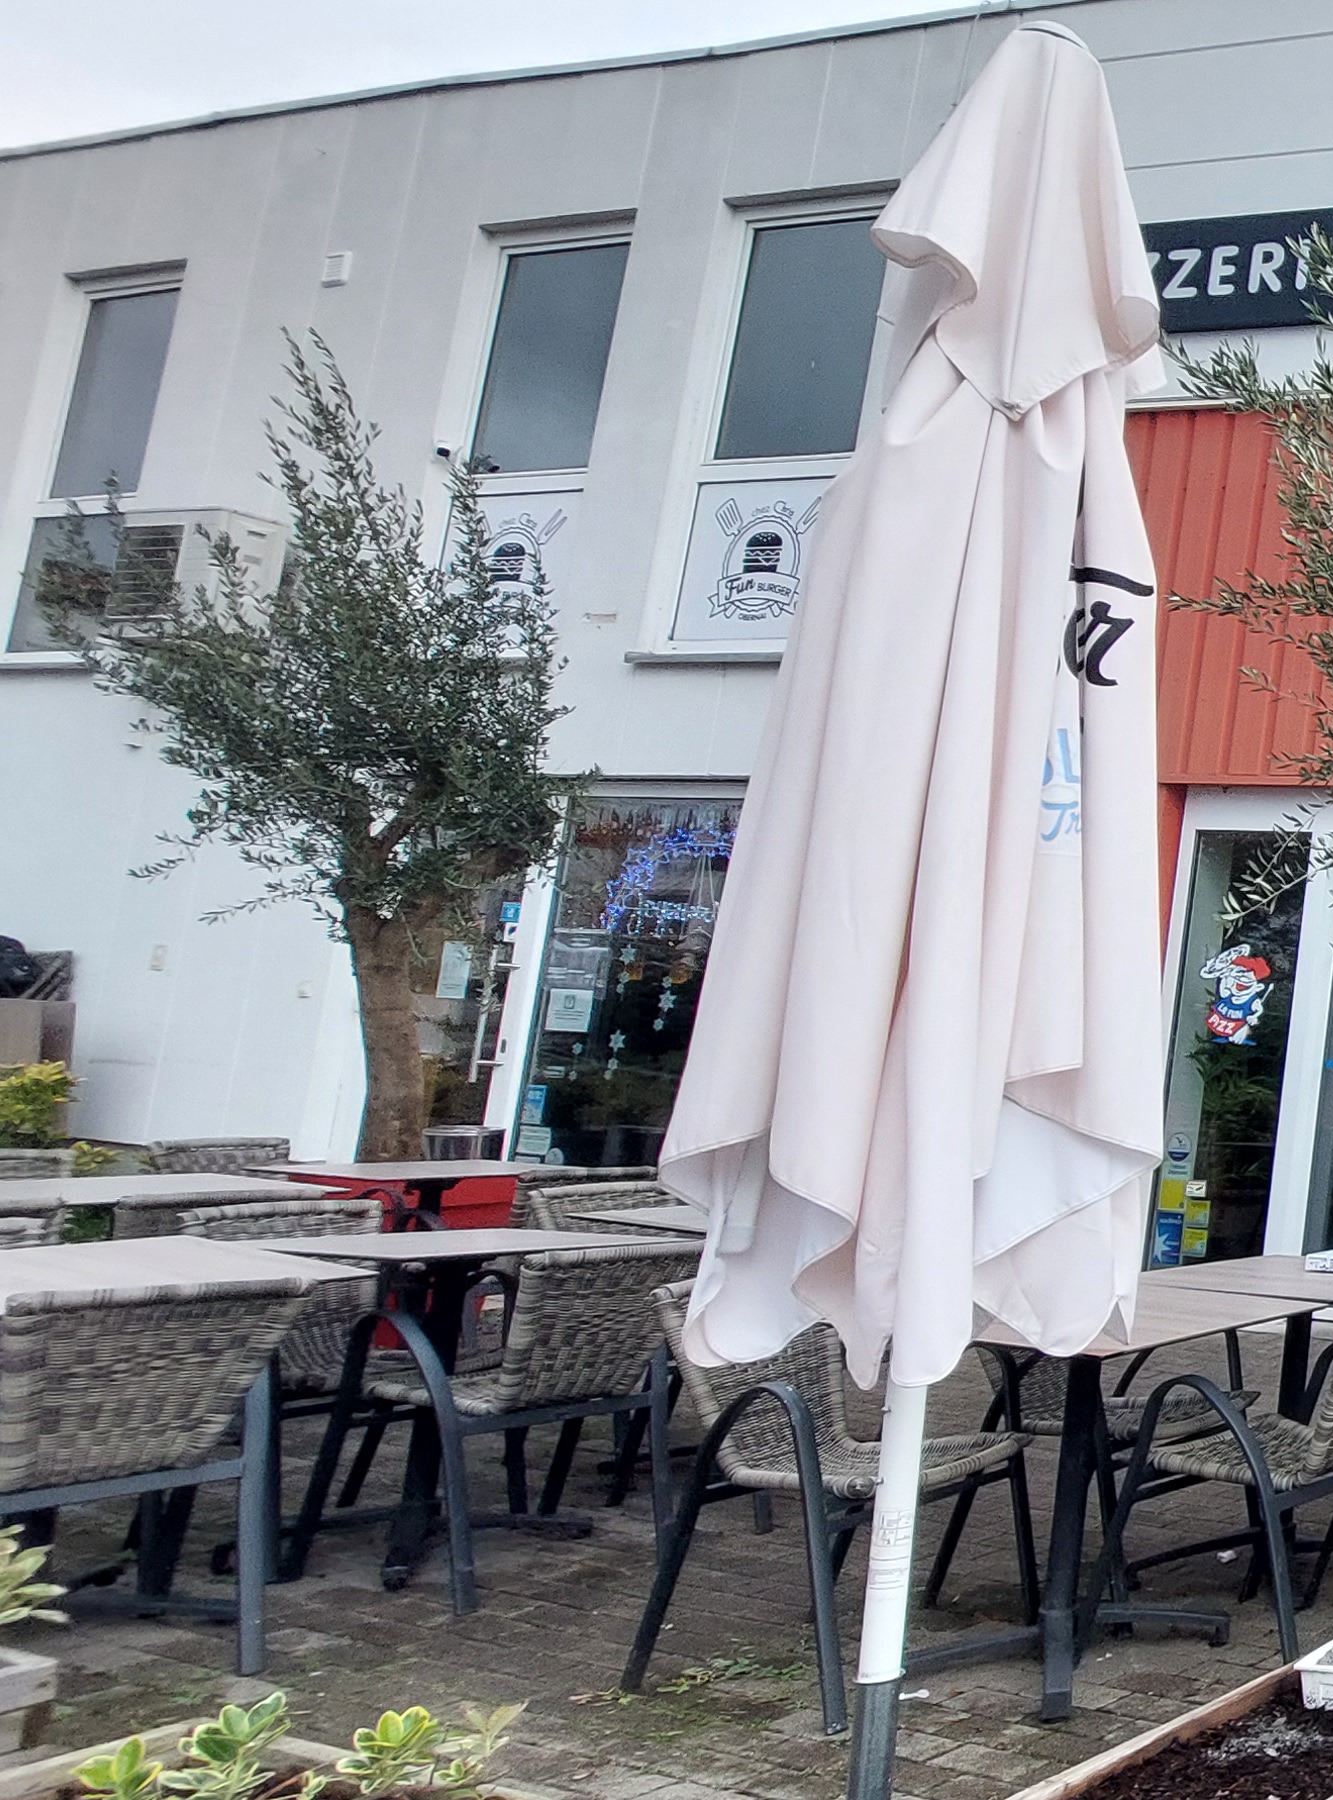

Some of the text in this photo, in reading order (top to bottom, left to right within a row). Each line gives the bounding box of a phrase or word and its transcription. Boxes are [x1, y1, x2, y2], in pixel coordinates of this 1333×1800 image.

[725, 576, 792, 601] Fun BURGER
[1217, 1003, 1243, 1019] LA FUN
[1207, 1014, 1236, 1035] PIZZ
